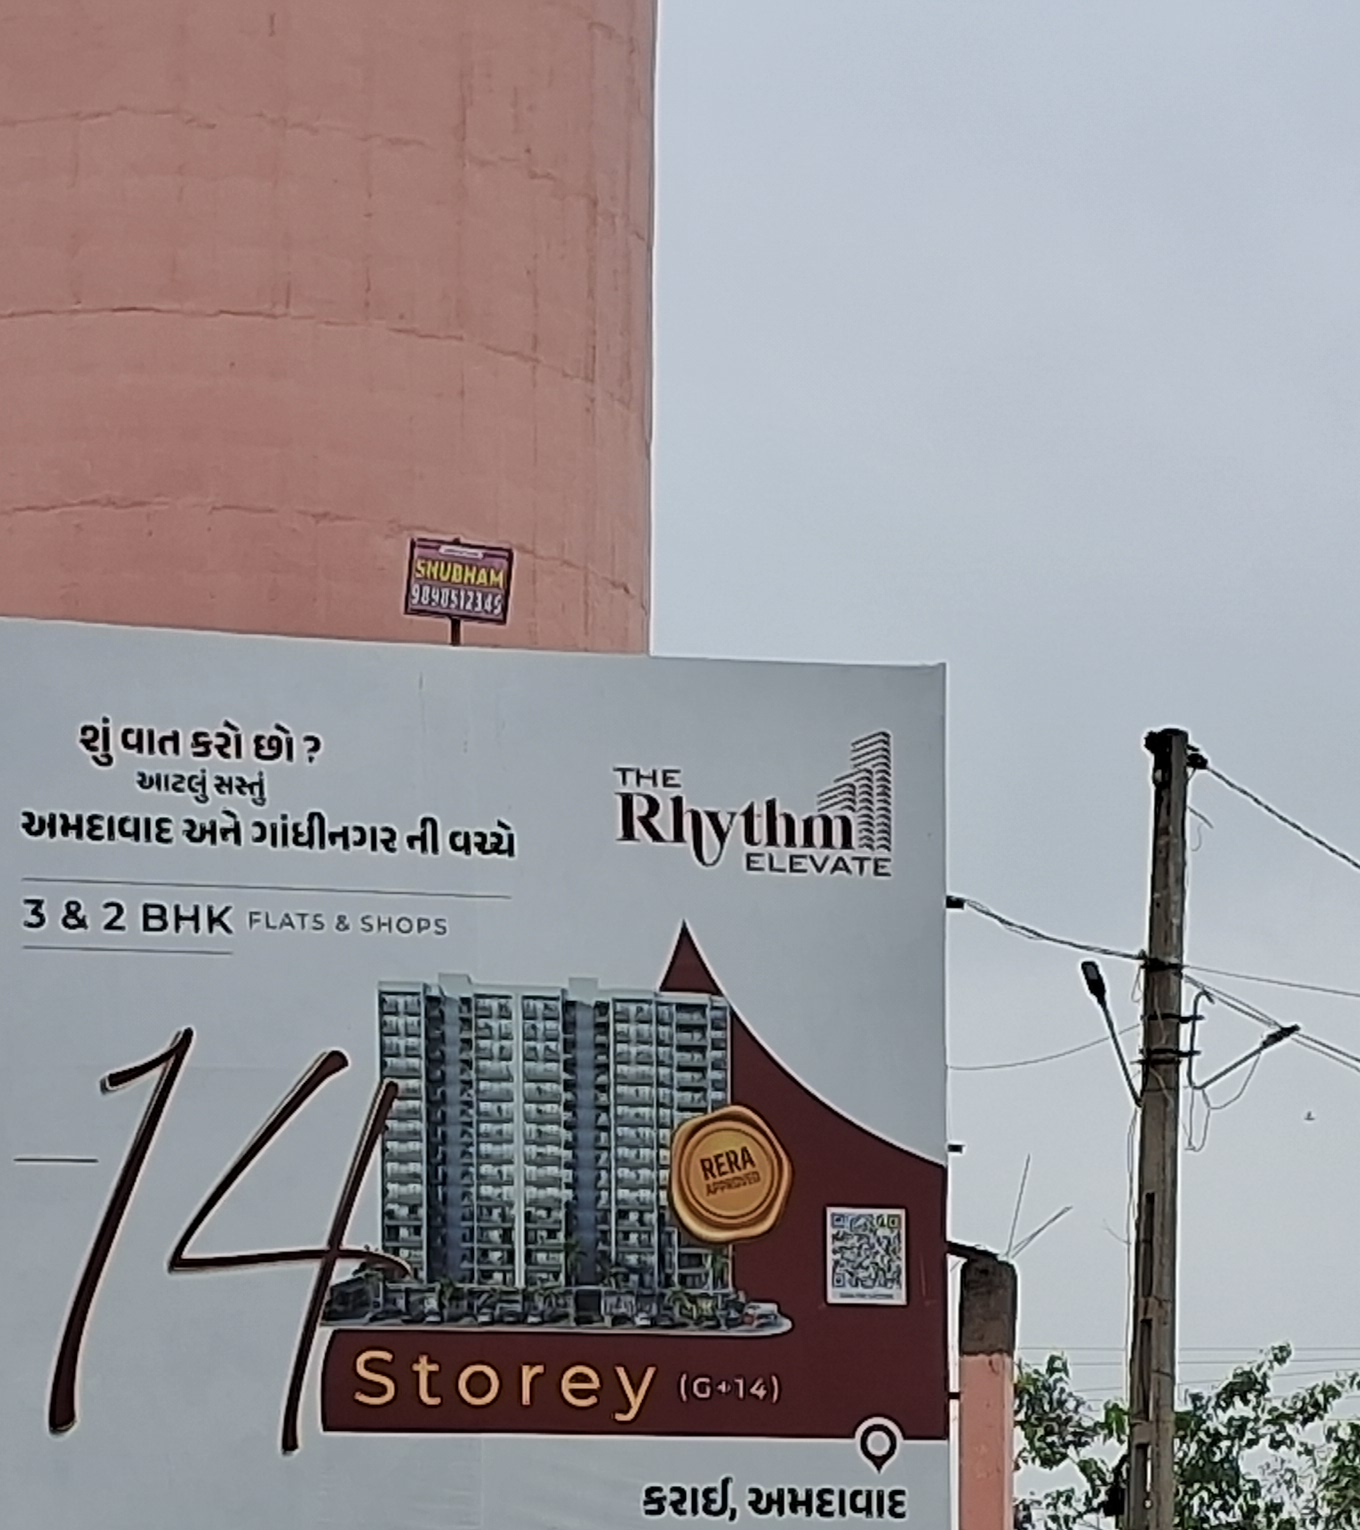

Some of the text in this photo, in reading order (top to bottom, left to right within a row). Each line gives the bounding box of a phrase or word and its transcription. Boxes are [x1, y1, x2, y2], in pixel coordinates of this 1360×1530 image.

[415, 558, 505, 589] SHUBHAM
[80, 717, 113, 766] શું
[121, 727, 180, 758] વાત
[191, 719, 242, 760] કરો
[253, 723, 294, 763] છો
[136, 768, 267, 806] આટલું સસ્તું
[613, 767, 681, 788] THE
[21, 809, 516, 859] અમદાવાદ અને ગાંધીનગર ની વચ્ચે
[614, 791, 855, 868] Rhythm
[745, 852, 892, 877] ELEVATE
[23, 899, 448, 936] 3 & 2 BHK FLATS & SHOPS
[700, 1146, 756, 1181] RERA
[705, 1171, 761, 1197] APPROVED
[48, 1027, 414, 1457] 14
[353, 1347, 781, 1422] Storey (G+14)
[642, 1476, 907, 1522] કરાઈ, અમદાવાદ
